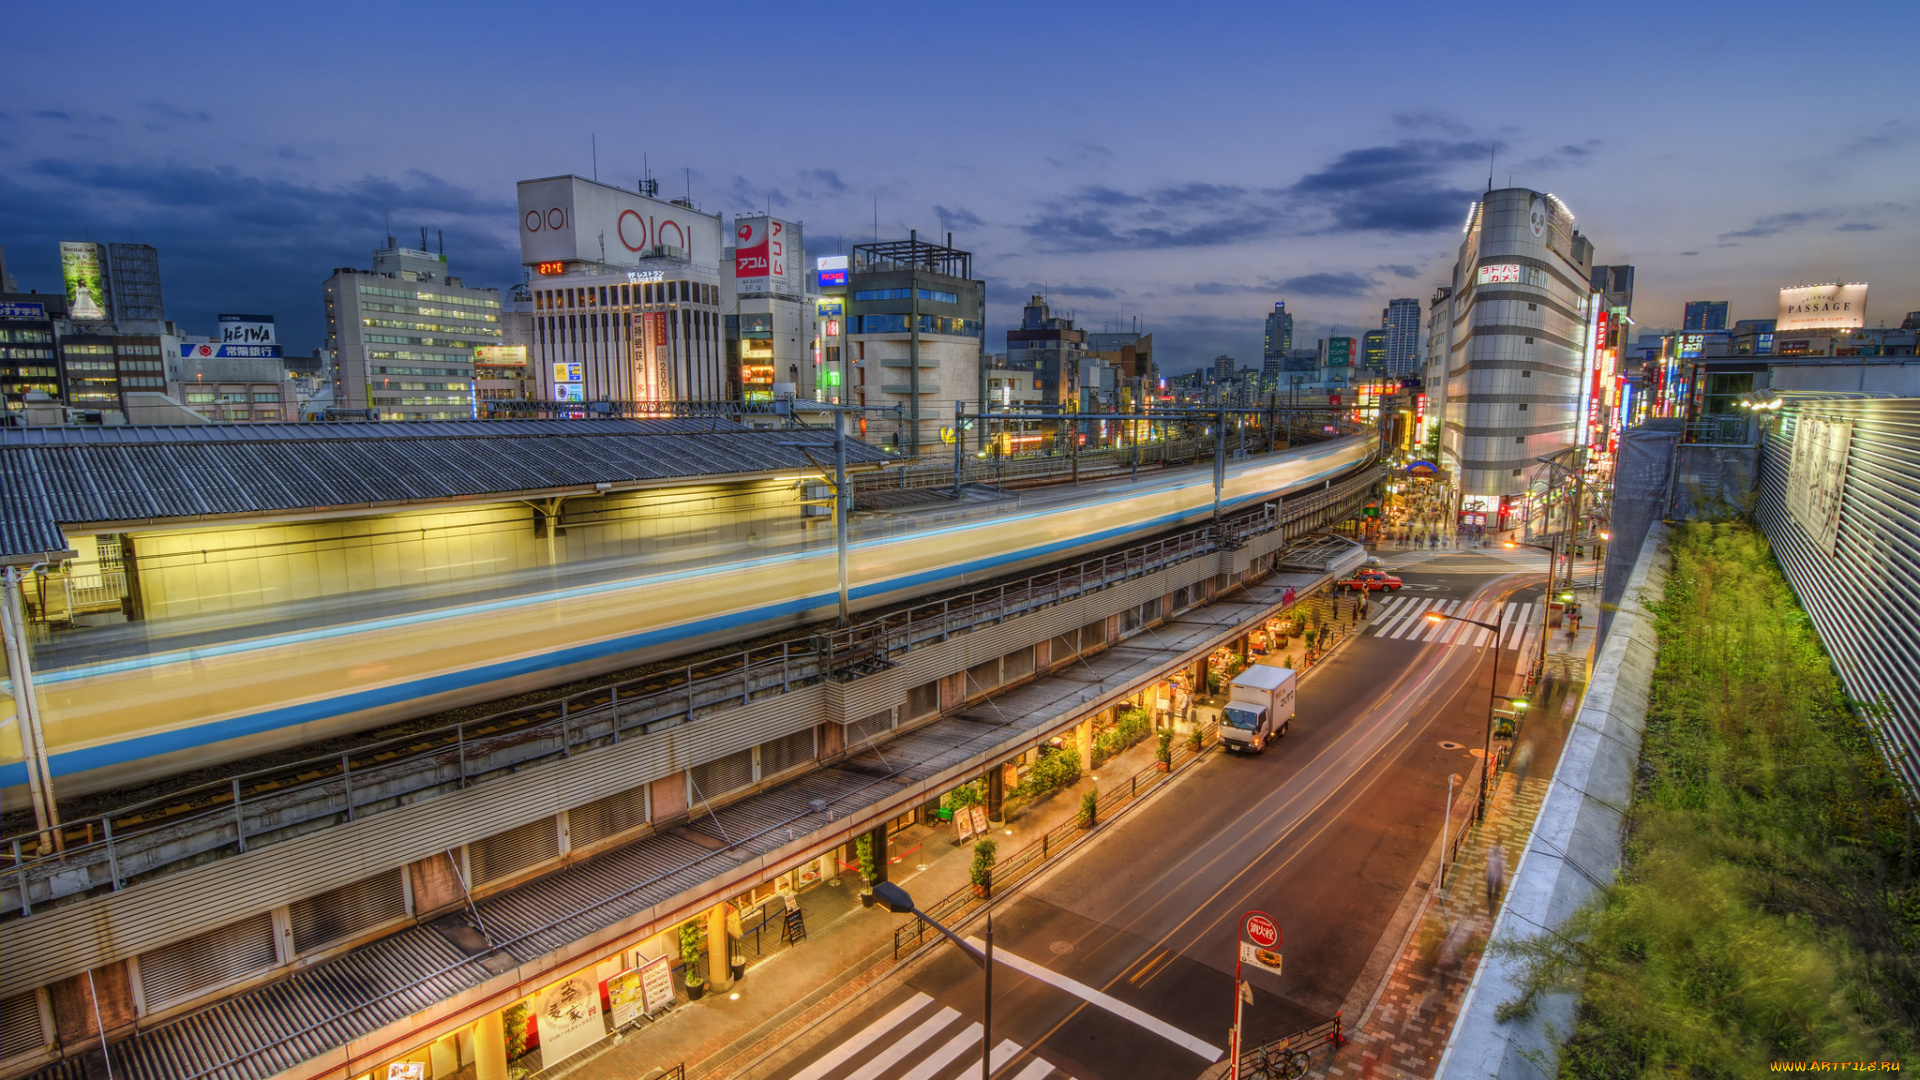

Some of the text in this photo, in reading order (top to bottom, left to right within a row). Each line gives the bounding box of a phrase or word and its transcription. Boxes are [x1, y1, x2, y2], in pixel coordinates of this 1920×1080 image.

[772, 221, 783, 275] アコム
[739, 256, 768, 270] アコム
[1491, 274, 1518, 282] カメラ
[1788, 302, 1851, 314] PASSAGE
[224, 325, 270, 343] HEIWA
[225, 346, 272, 357] 常陽銀行
[1250, 922, 1274, 941] 消火栓
